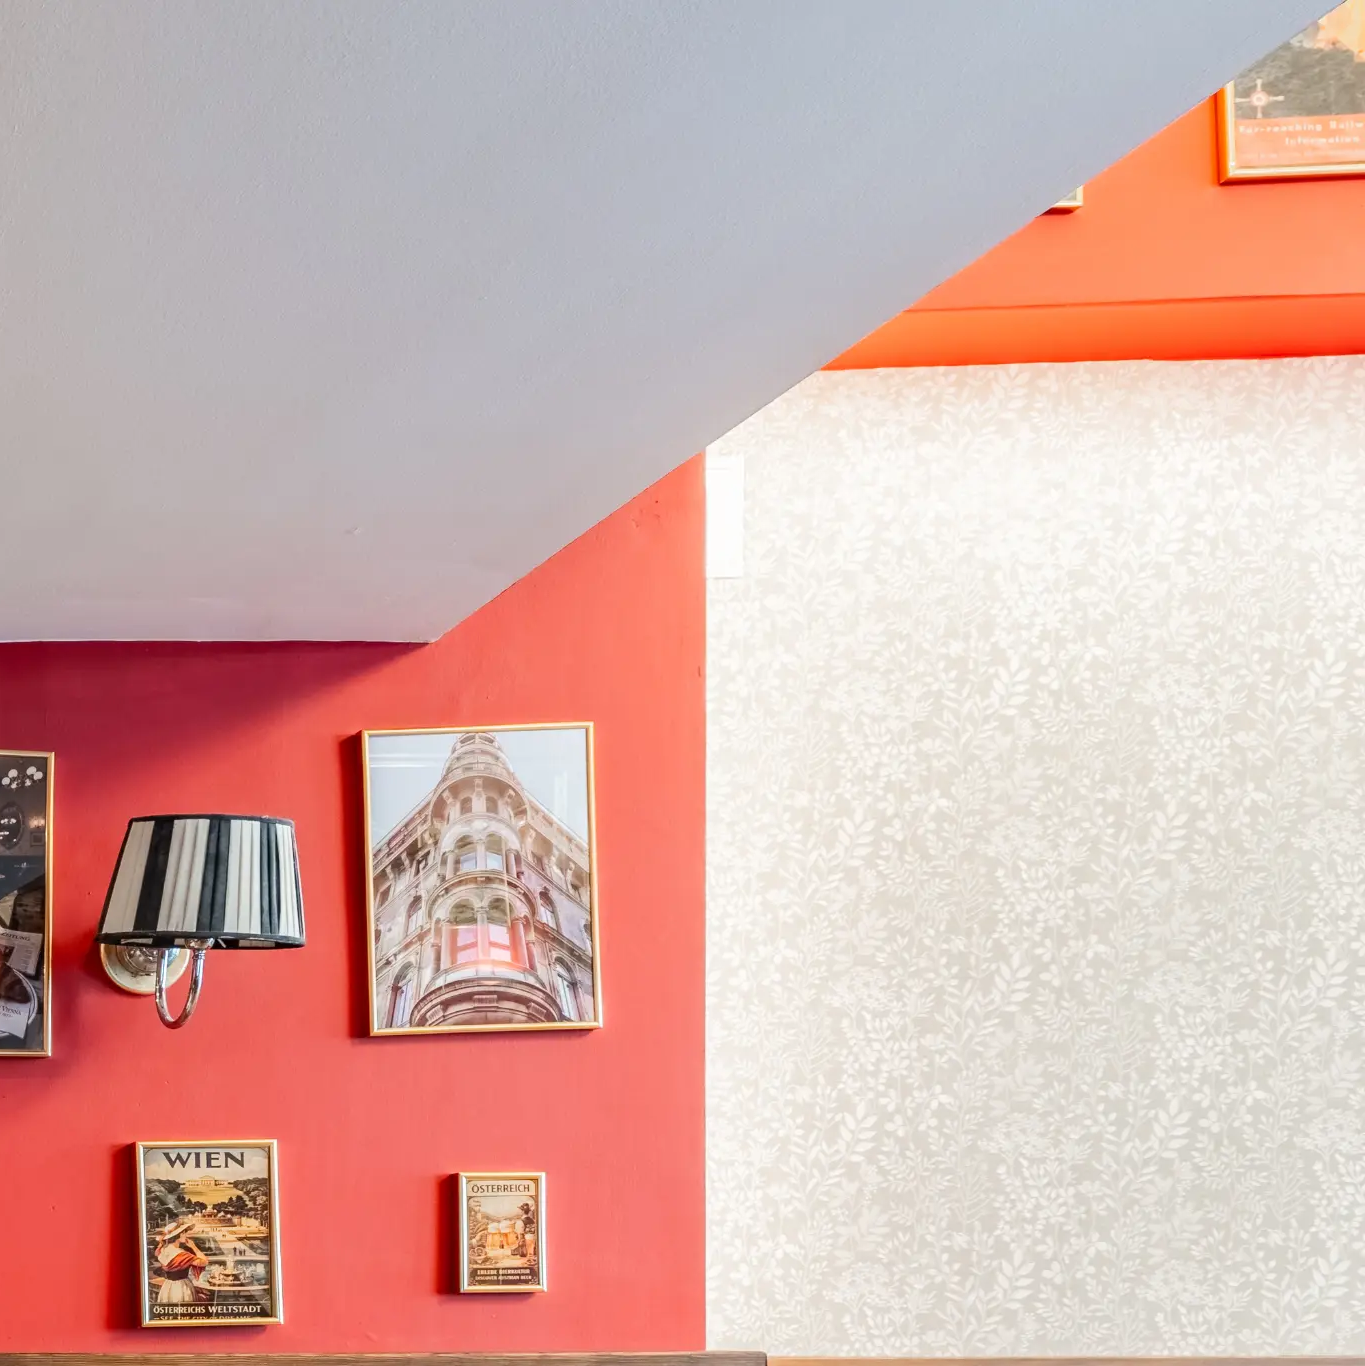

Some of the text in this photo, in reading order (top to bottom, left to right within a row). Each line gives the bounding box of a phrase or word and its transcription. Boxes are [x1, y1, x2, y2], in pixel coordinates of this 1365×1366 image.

[162, 1151, 245, 1168] WIEN
[471, 1184, 530, 1194] ÖSTERREICH
[153, 1305, 262, 1314] ÖSTERREICHS WELTSTADT
